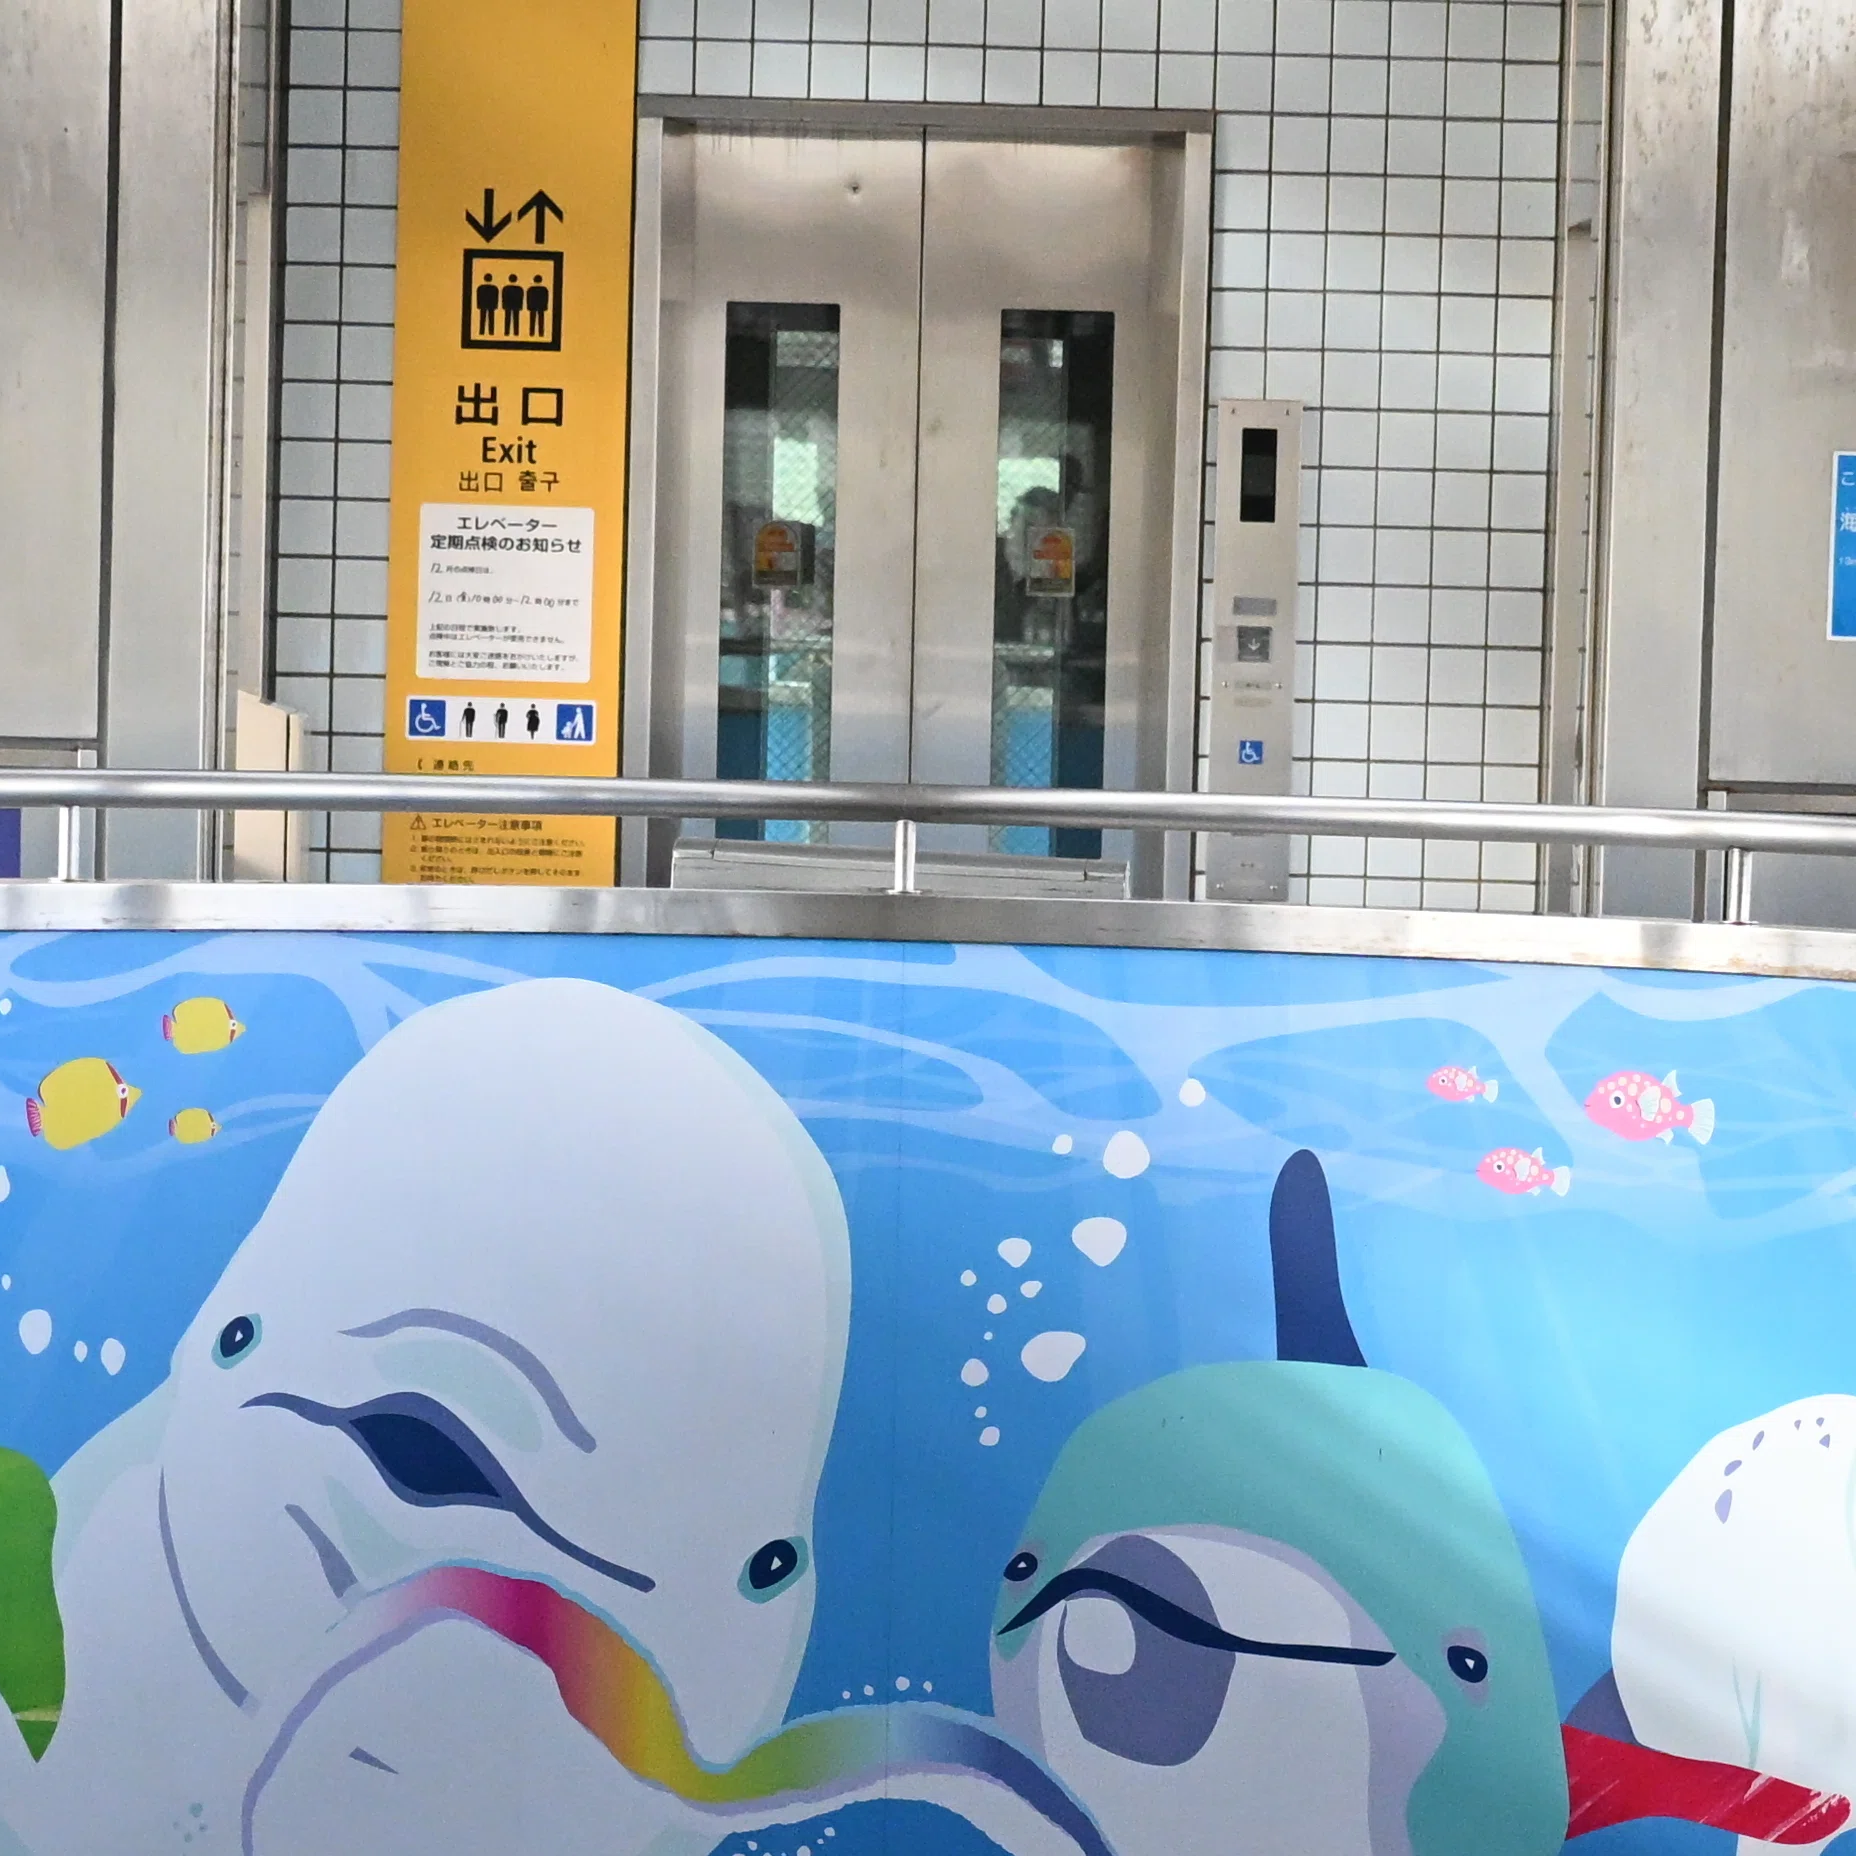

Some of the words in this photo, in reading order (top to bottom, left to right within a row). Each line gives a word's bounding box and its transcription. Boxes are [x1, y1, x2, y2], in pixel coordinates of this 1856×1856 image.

[455, 382, 563, 427] 出口
[482, 435, 537, 464] Exit
[459, 470, 503, 492] 出口
[518, 470, 560, 493] 출구
[456, 516, 557, 532] エレベーター
[430, 534, 582, 554] 定期点検のお知らせ
[432, 818, 543, 831] エレベーター注意事項
